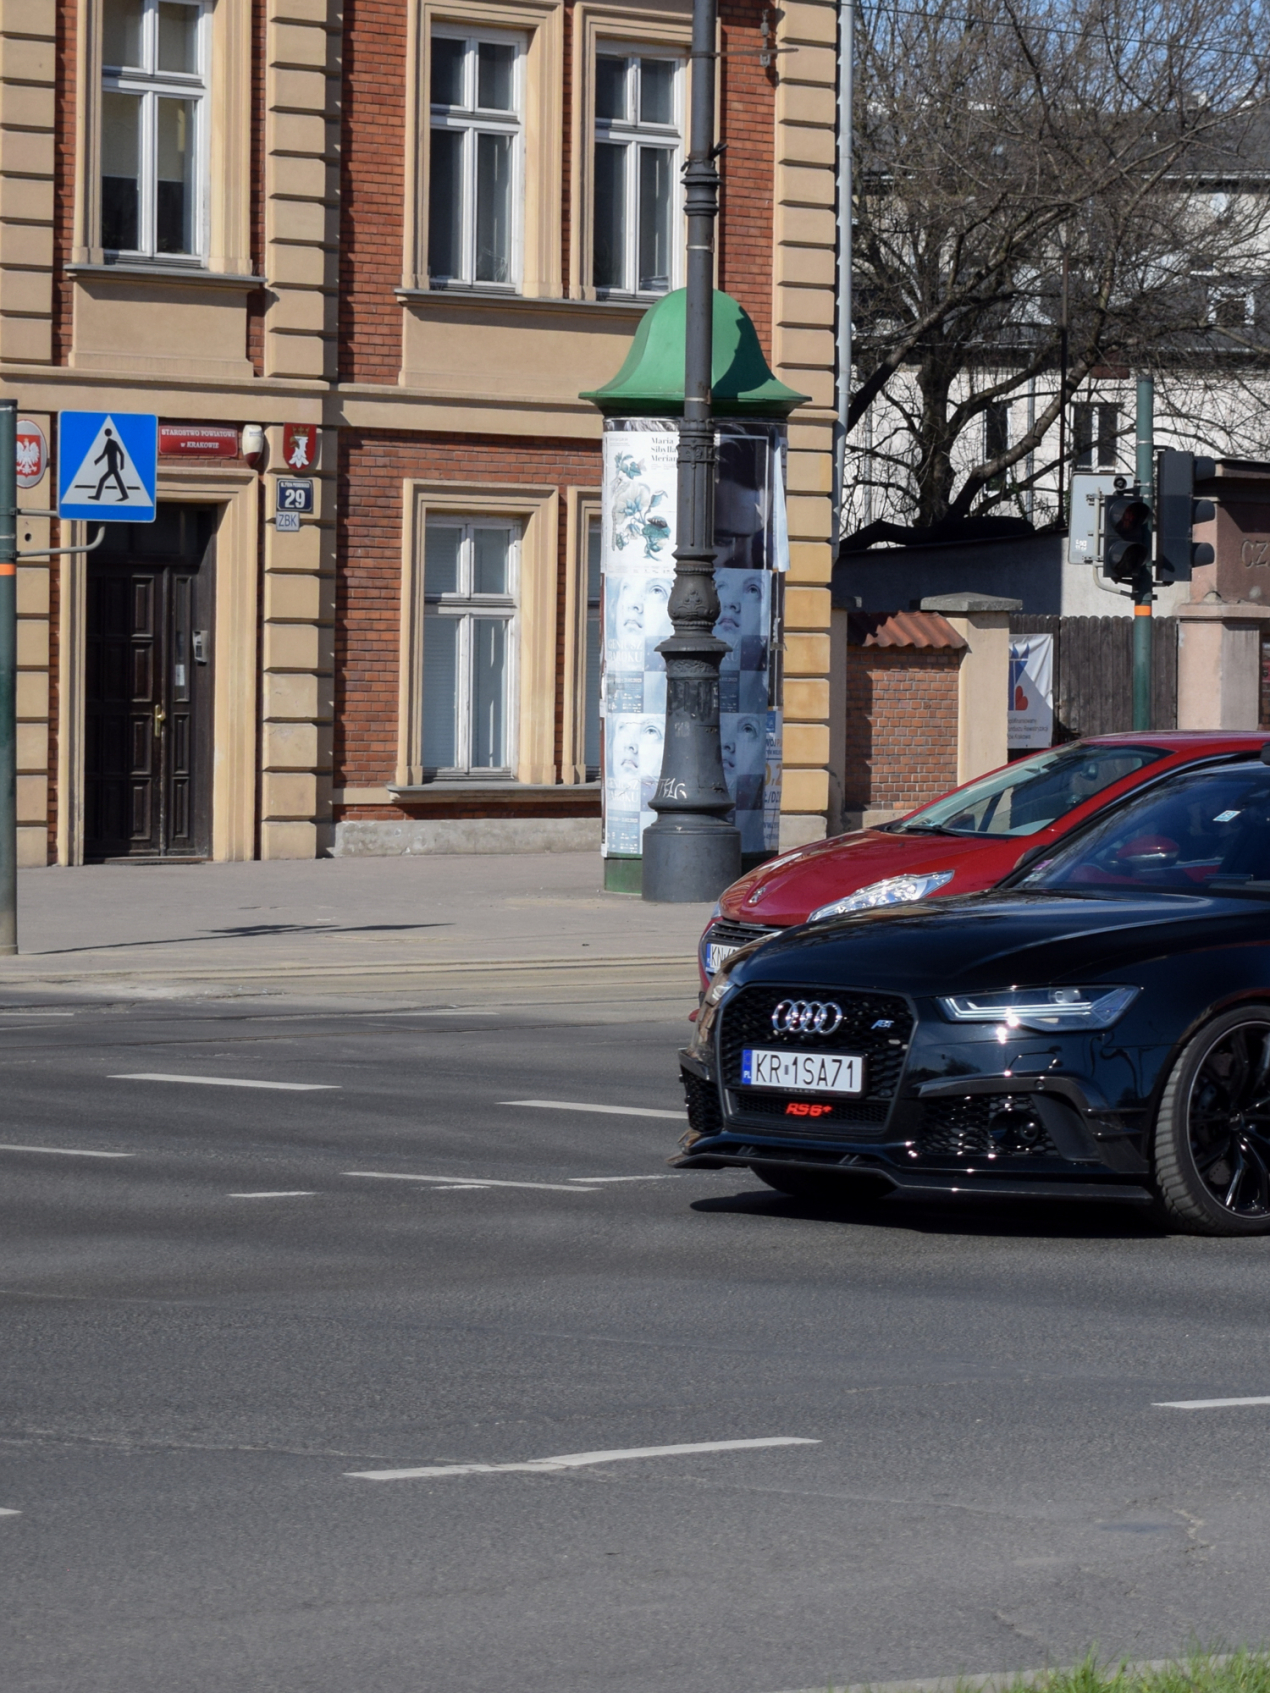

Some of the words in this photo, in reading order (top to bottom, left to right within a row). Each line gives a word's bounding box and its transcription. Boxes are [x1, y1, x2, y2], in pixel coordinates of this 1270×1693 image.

[161, 428, 200, 437] STAROSTWO
[201, 430, 236, 438] POWIATOWE
[187, 441, 220, 449] KRAKOWIE
[284, 488, 306, 508] 29
[278, 514, 297, 527] ZBK
[871, 1019, 894, 1029] ABT
[743, 1070, 751, 1079] PL
[755, 1053, 782, 1083] KR
[791, 1056, 854, 1088] 1SA71
